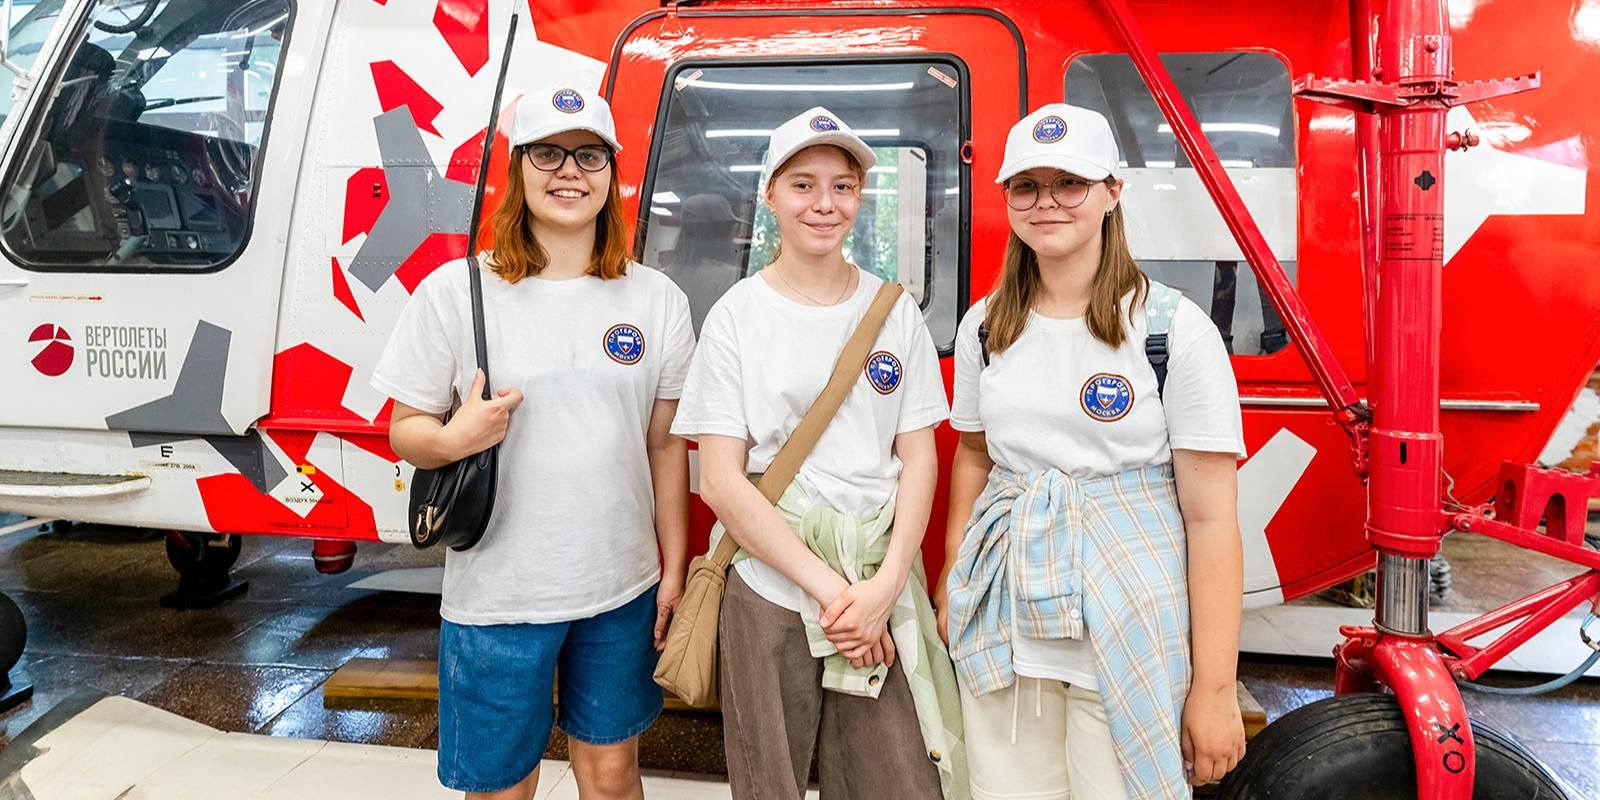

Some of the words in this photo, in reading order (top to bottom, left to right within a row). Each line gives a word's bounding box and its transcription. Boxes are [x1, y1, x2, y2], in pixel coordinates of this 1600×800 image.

[85, 325, 167, 349] ВЕРТОЛЕТЫ
[86, 348, 167, 380] РОССИИ
[1090, 405, 1121, 417] МОСКВА
